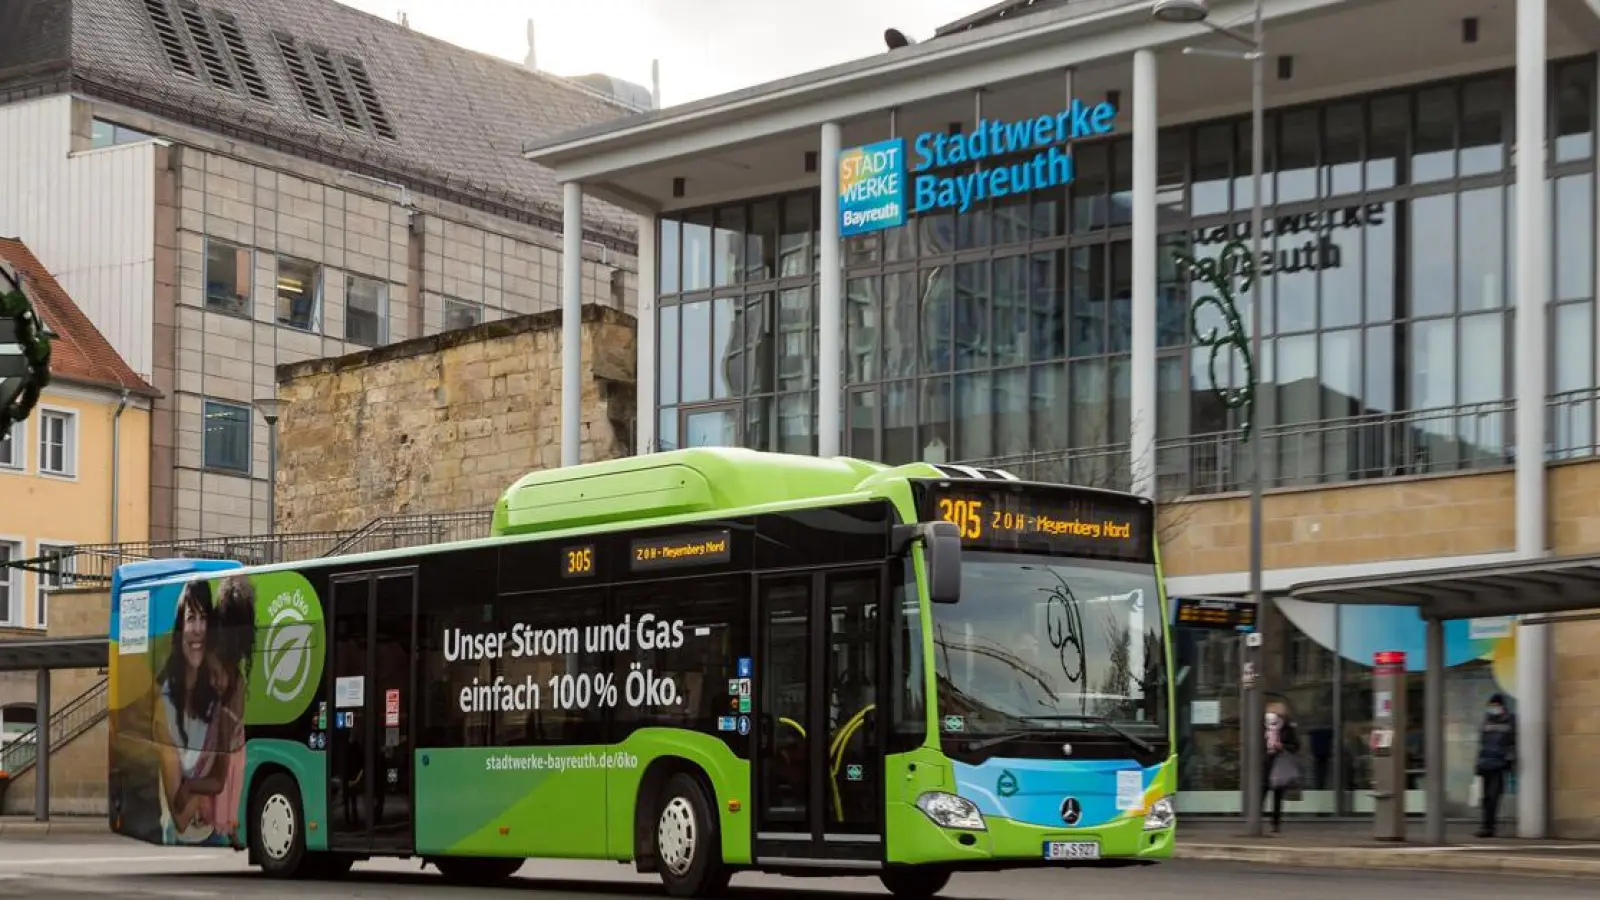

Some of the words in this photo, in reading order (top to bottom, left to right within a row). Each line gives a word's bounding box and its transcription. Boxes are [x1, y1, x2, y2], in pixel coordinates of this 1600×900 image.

[914, 97, 1117, 172] Stadtwerke
[842, 147, 900, 179] STADT
[843, 171, 899, 204] WERKE
[914, 146, 1075, 215] Bayreuth
[843, 202, 899, 228] Bayreuth
[939, 498, 982, 539] 305
[1103, 520, 1130, 538] Nord
[568, 548, 591, 574] 305
[706, 540, 725, 553] Nord
[444, 628, 507, 662] Unser
[511, 622, 579, 657] Strom
[585, 614, 630, 653] und
[636, 613, 684, 650] Gas
[459, 675, 540, 713] einfach
[625, 662, 683, 707] Öko.
[485, 752, 638, 773] stadtwerke-bayreuth.de/öko
